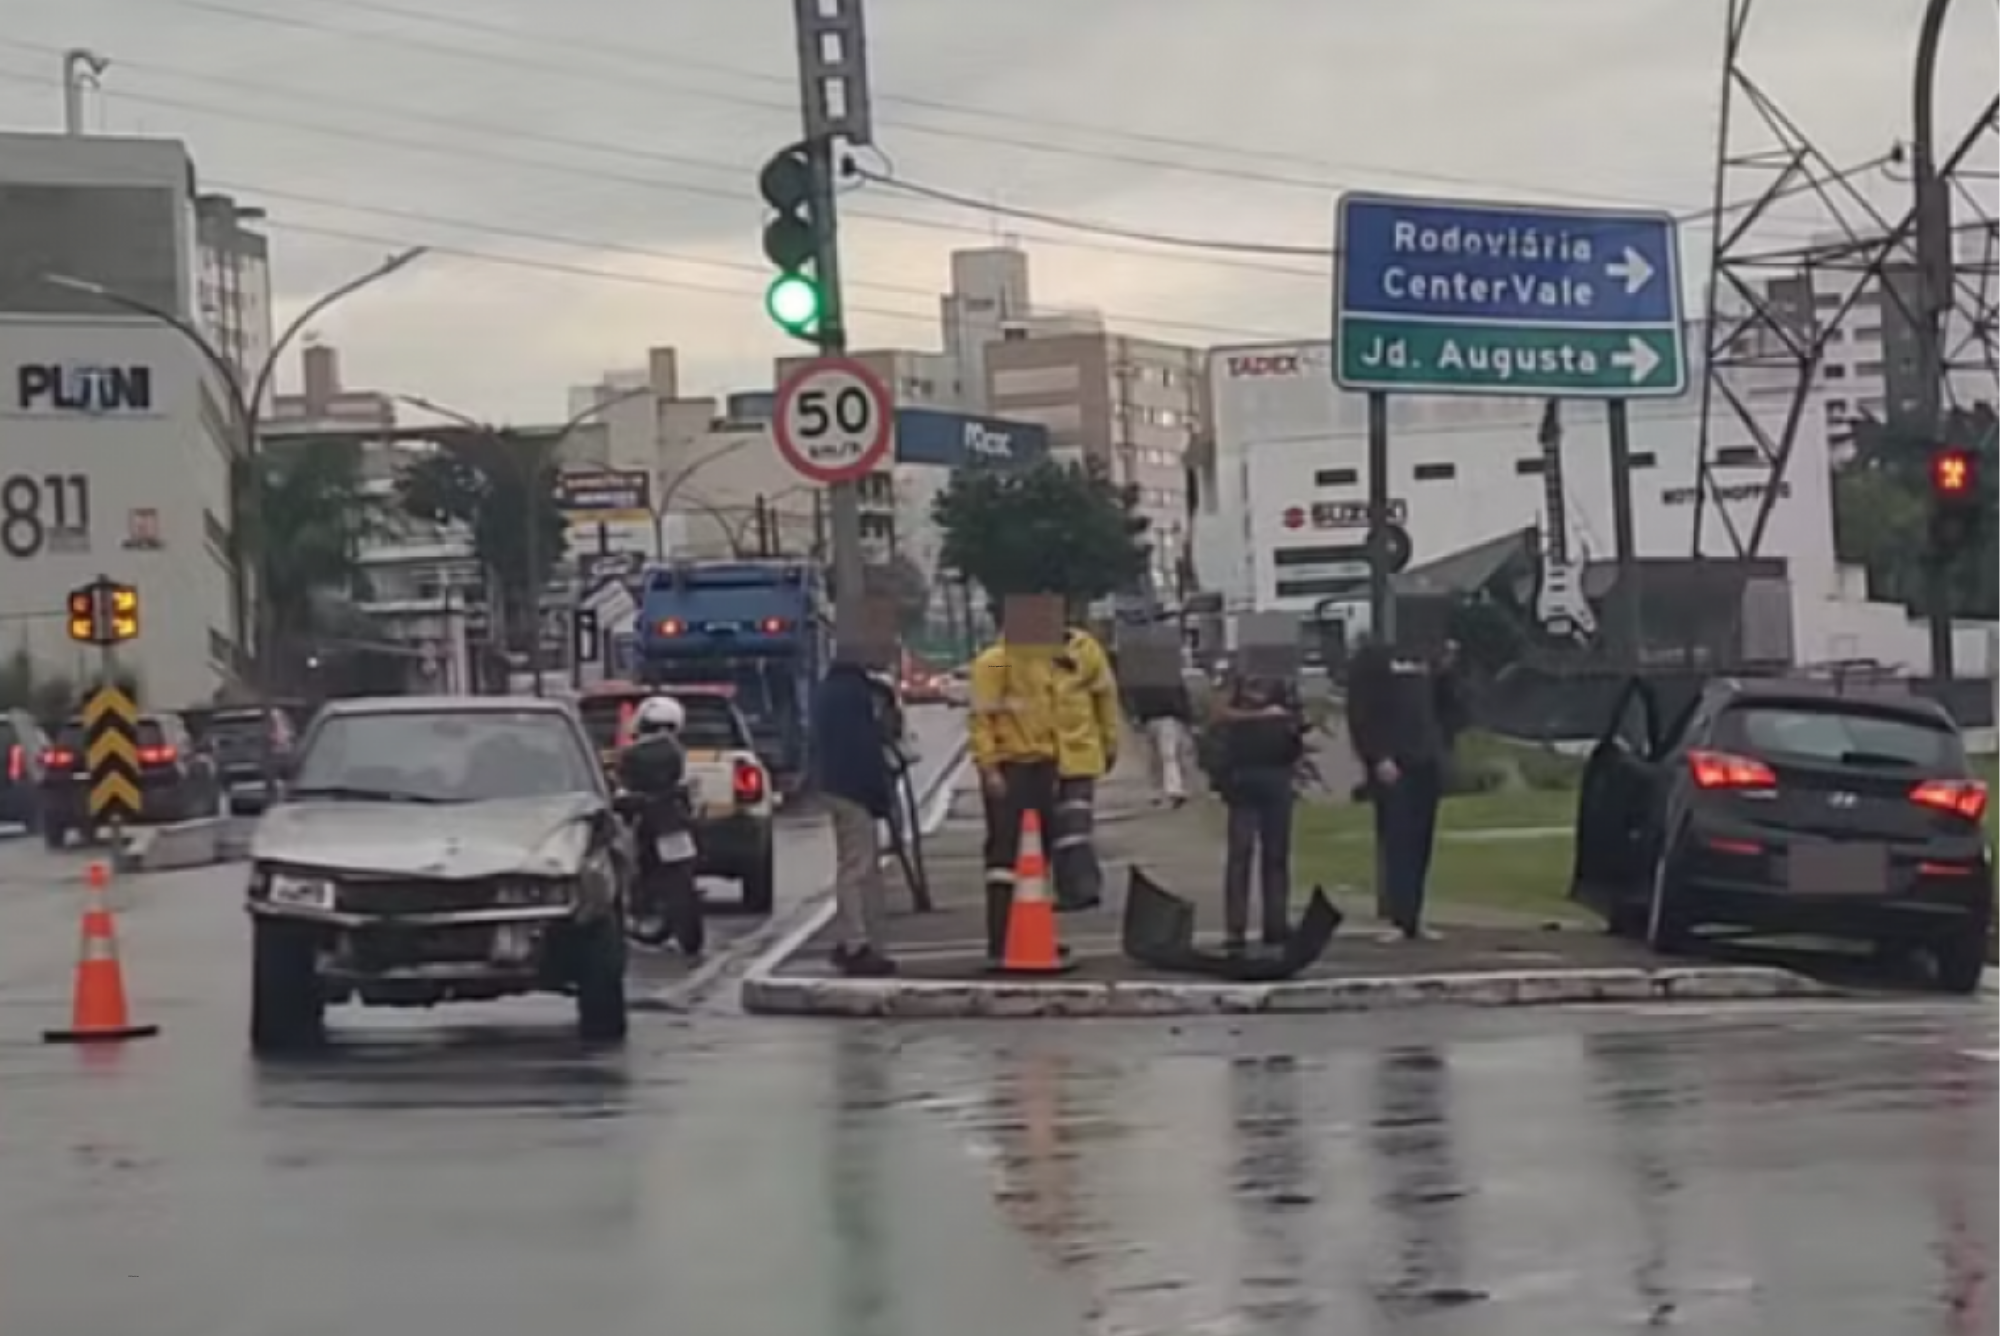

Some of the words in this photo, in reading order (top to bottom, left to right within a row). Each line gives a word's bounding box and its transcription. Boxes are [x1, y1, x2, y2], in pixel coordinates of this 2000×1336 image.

[1394, 221, 1592, 263] Rodoviária
[1361, 336, 1422, 369] Jd.
[1437, 339, 1598, 379] Augusta
[797, 385, 869, 439] 50
[0, 473, 88, 558] 811
